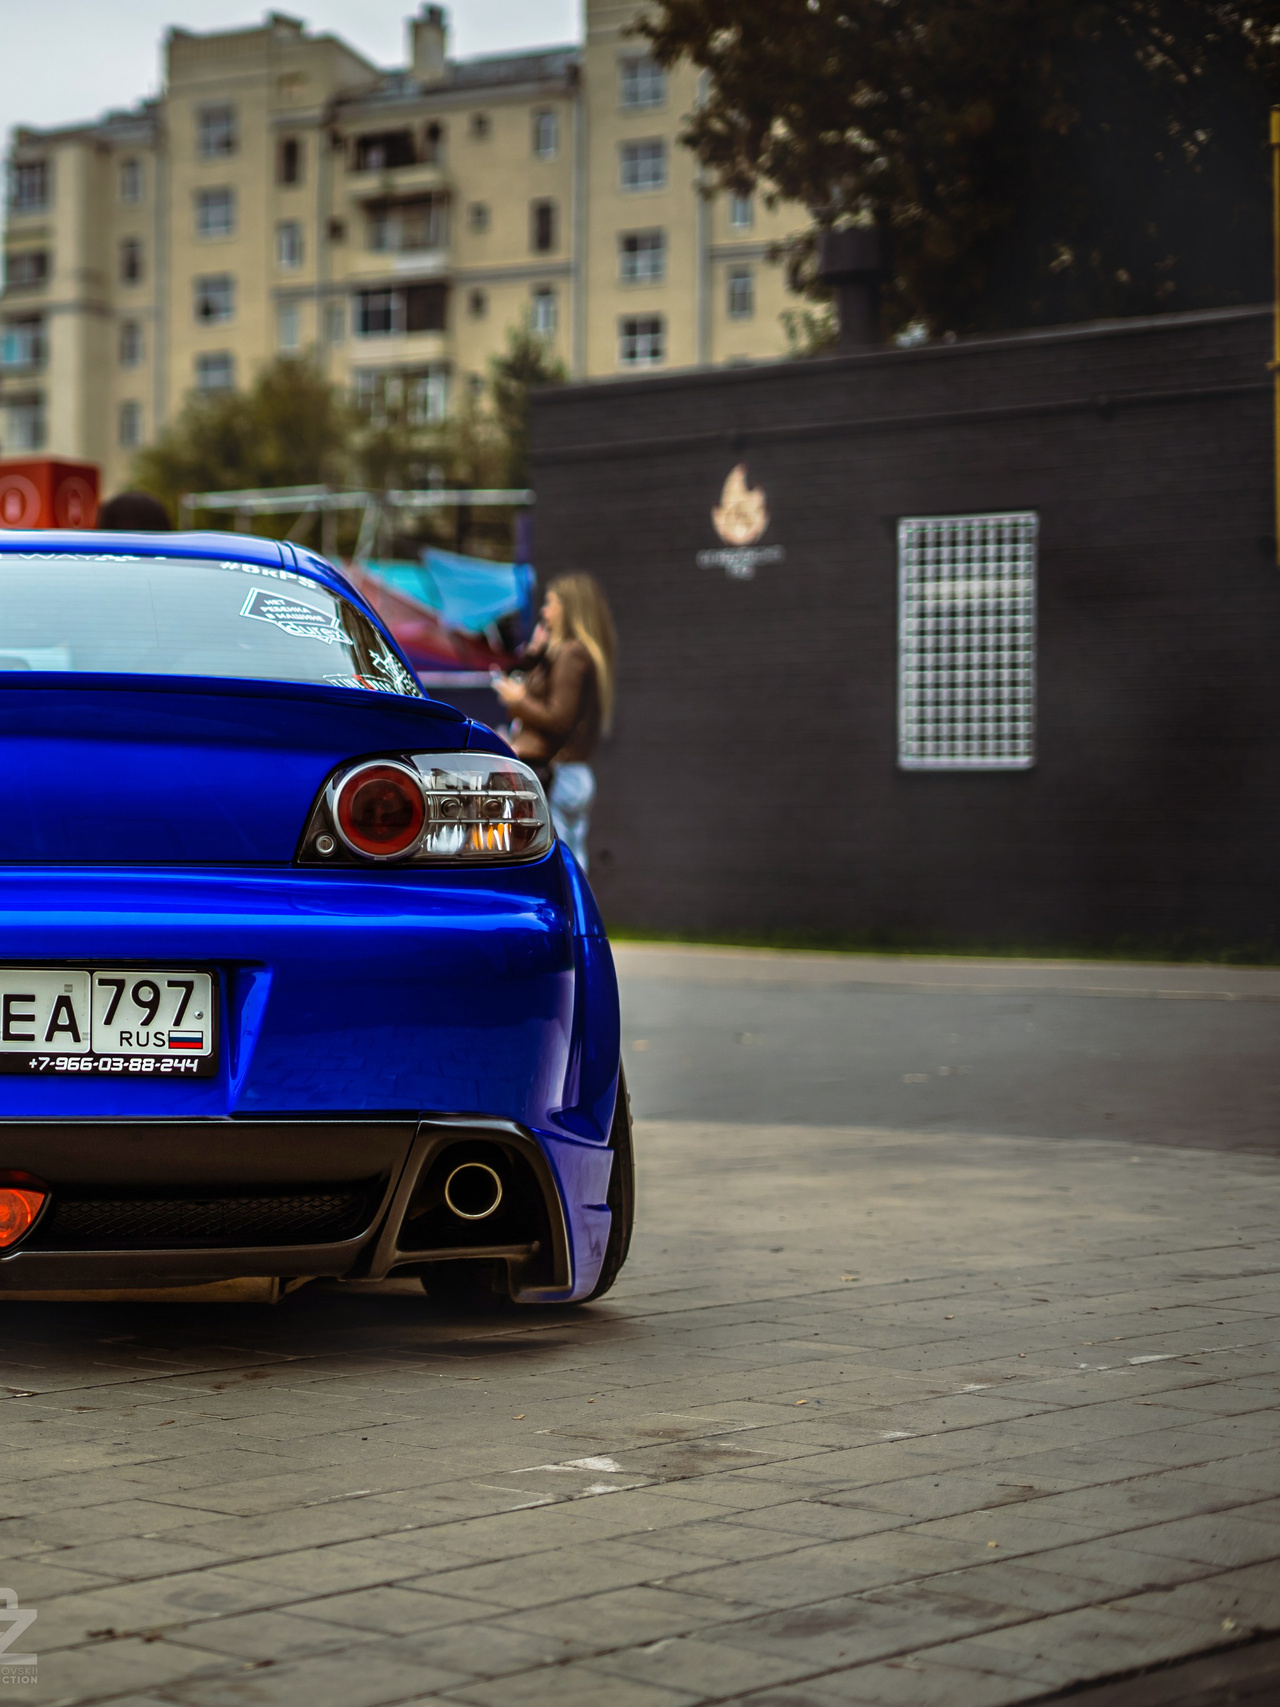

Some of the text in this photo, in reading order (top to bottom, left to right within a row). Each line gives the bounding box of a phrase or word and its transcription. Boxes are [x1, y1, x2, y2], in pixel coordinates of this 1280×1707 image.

[284, 622, 345, 640] durex
[97, 979, 194, 1027] 797
[120, 1031, 166, 1047] RUS
[29, 1056, 199, 1073] +7-966-03-88-244
